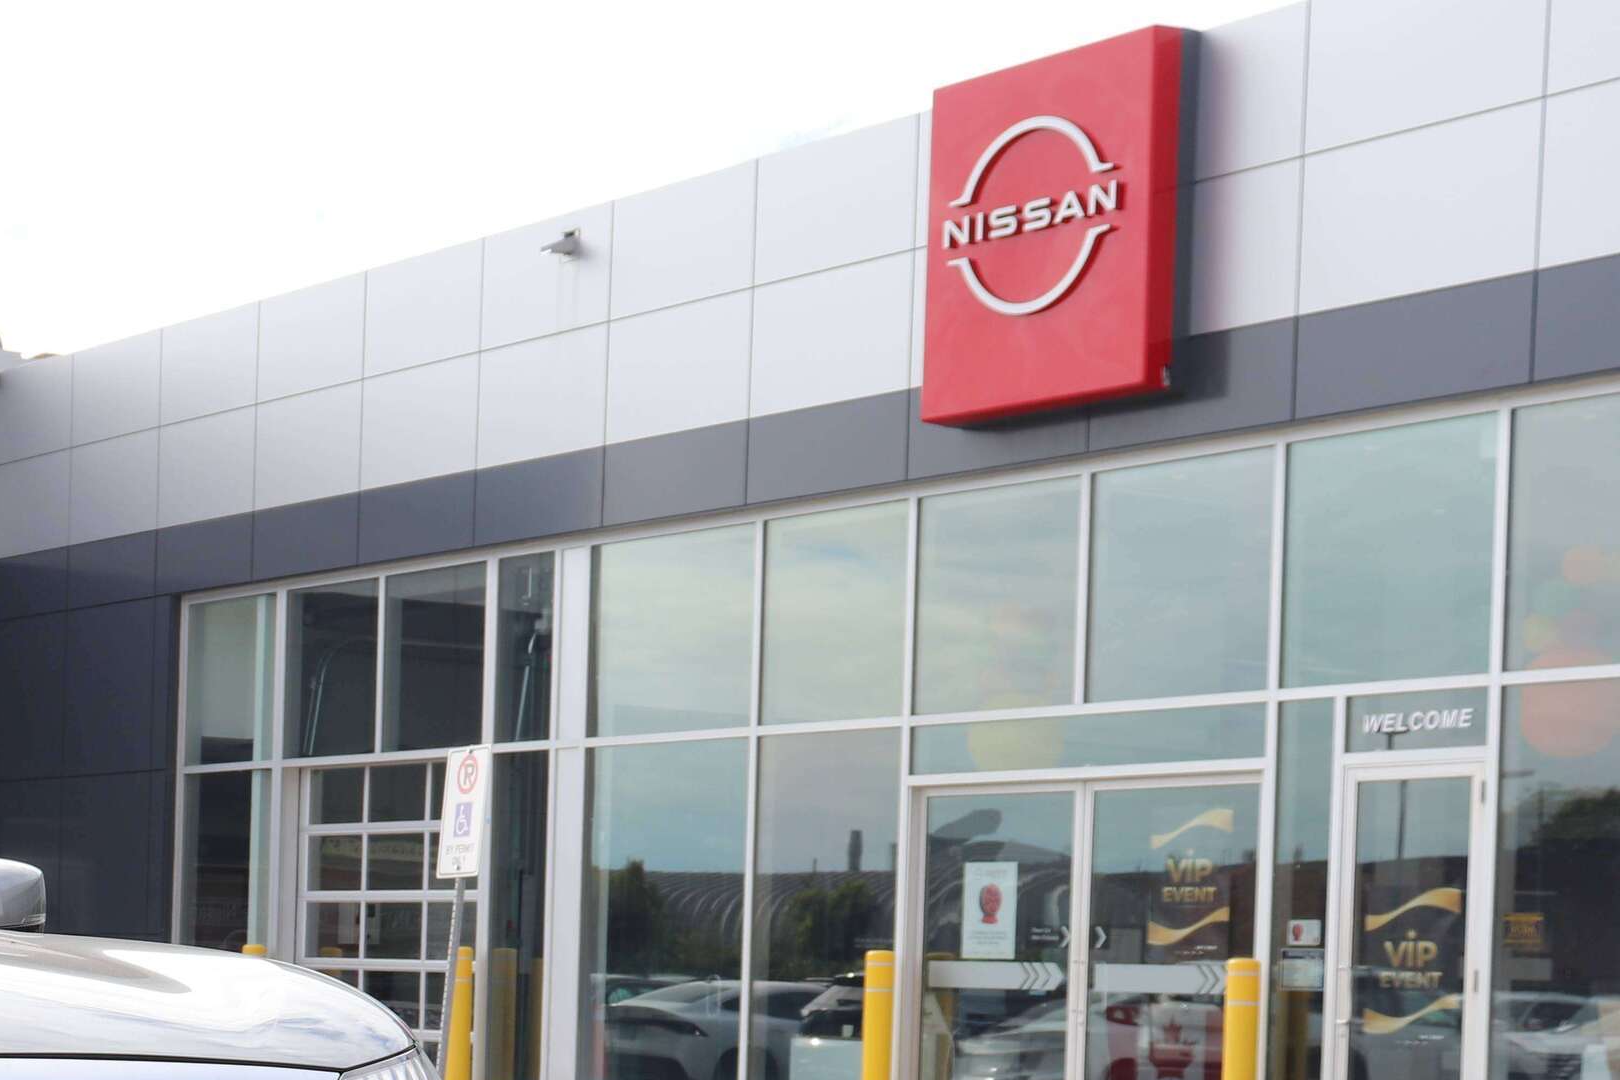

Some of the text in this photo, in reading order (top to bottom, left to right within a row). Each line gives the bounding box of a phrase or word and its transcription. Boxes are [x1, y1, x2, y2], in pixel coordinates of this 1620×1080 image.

[942, 179, 1118, 250] NISSAN
[1363, 708, 1474, 733] WELCOME
[1166, 857, 1213, 884] VIP
[1163, 886, 1217, 903] EVENT
[1383, 940, 1438, 968] VIP
[1378, 971, 1443, 988] EVENT
